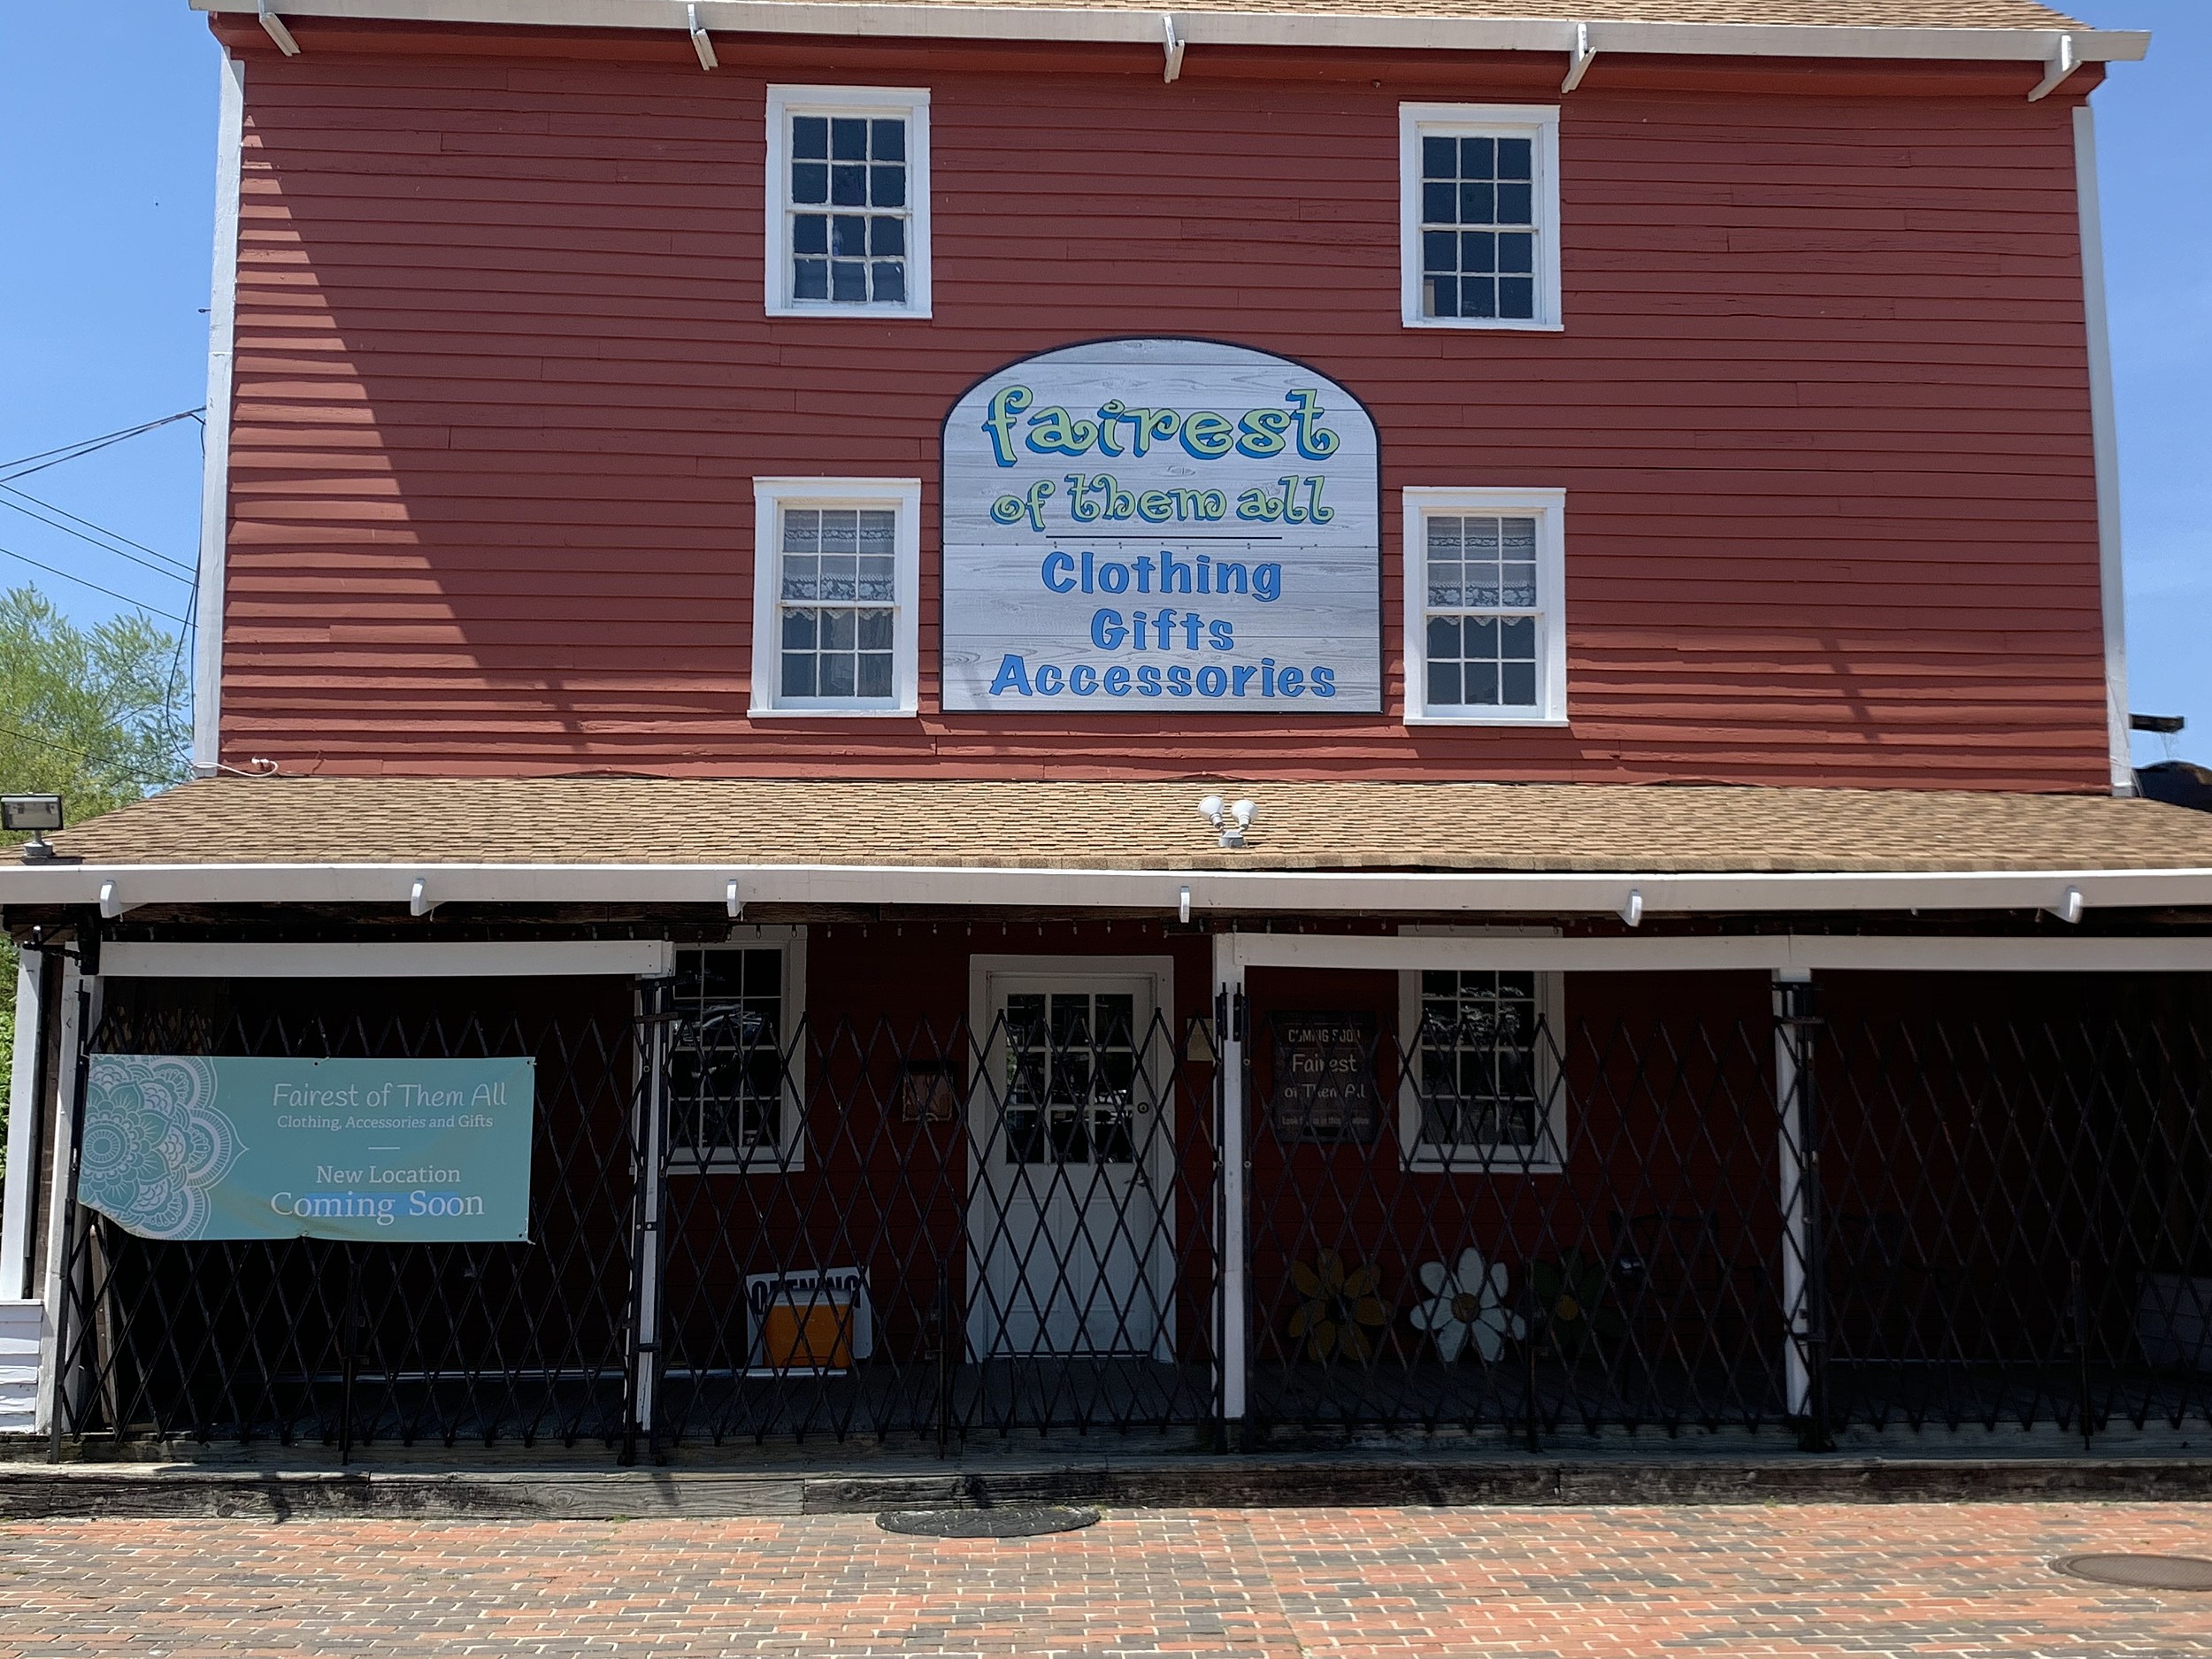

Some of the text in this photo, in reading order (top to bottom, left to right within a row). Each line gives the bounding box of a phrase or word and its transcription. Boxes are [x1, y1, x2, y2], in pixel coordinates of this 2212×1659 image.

[981, 385, 1340, 467] fairest
[990, 472, 1336, 532] of them all
[1041, 550, 1282, 602] Clothing
[1090, 608, 1234, 651] Gifts
[989, 654, 1337, 698] Accessories
[1292, 1053, 1357, 1073] Fairest
[273, 1081, 508, 1108] Fairest of Them All
[277, 1114, 494, 1132] Clothing, Accessories and Gifts
[315, 1164, 461, 1184] New Location
[271, 1189, 485, 1226] Coming Soon
